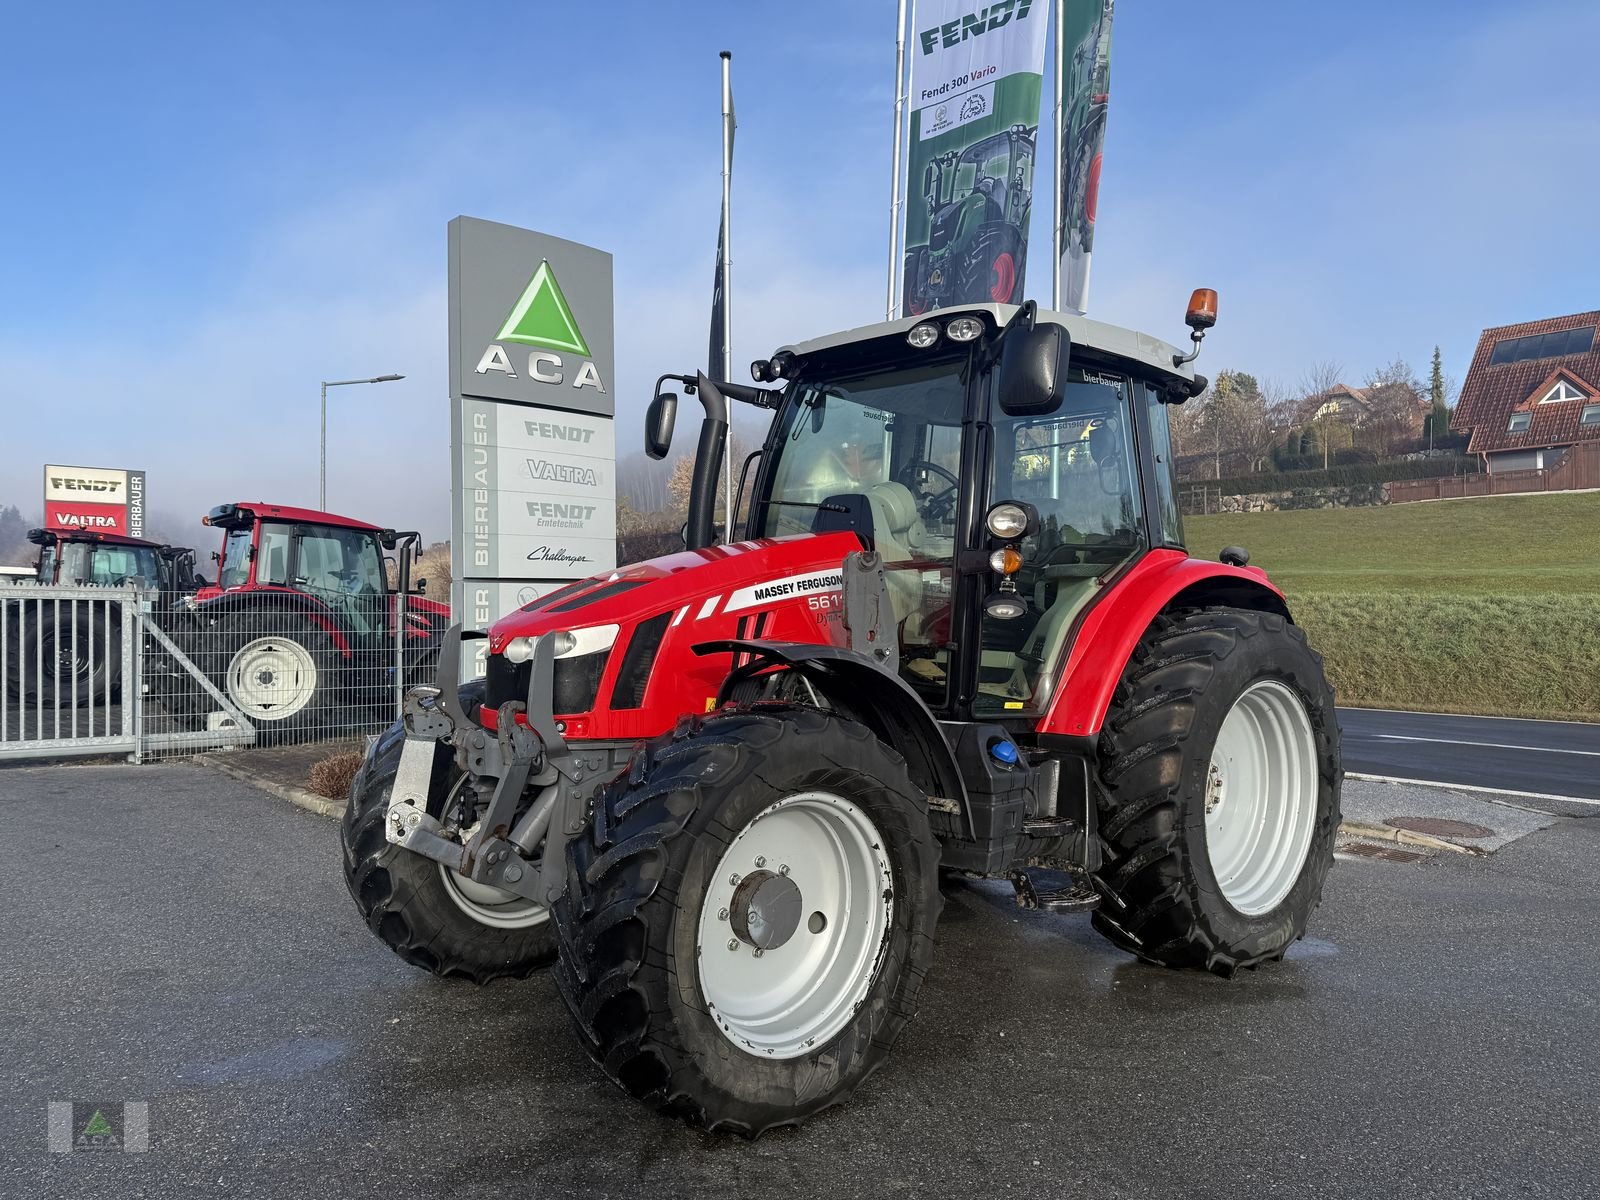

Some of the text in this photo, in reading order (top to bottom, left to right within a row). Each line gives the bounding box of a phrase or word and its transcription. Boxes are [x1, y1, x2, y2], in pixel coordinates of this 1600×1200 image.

[920, 0, 1032, 56] FENDT
[921, 65, 997, 101] Fendt 300 Vario
[474, 344, 606, 394] ACA
[1082, 369, 1122, 388] bierbauer
[524, 420, 595, 443] FENDT
[50, 477, 121, 493] FENDT
[526, 458, 597, 487] VALTRA
[473, 412, 489, 567] BIERBAUER
[55, 512, 117, 527] VALTRA
[131, 476, 142, 538] BIERBAUER
[526, 501, 596, 521] FENDT
[536, 517, 584, 529] Erntetechnik
[526, 545, 594, 567] Challenger
[754, 574, 843, 601] MASSEY FERGUSON
[808, 594, 843, 610] 561
[475, 588, 489, 677] ENER
